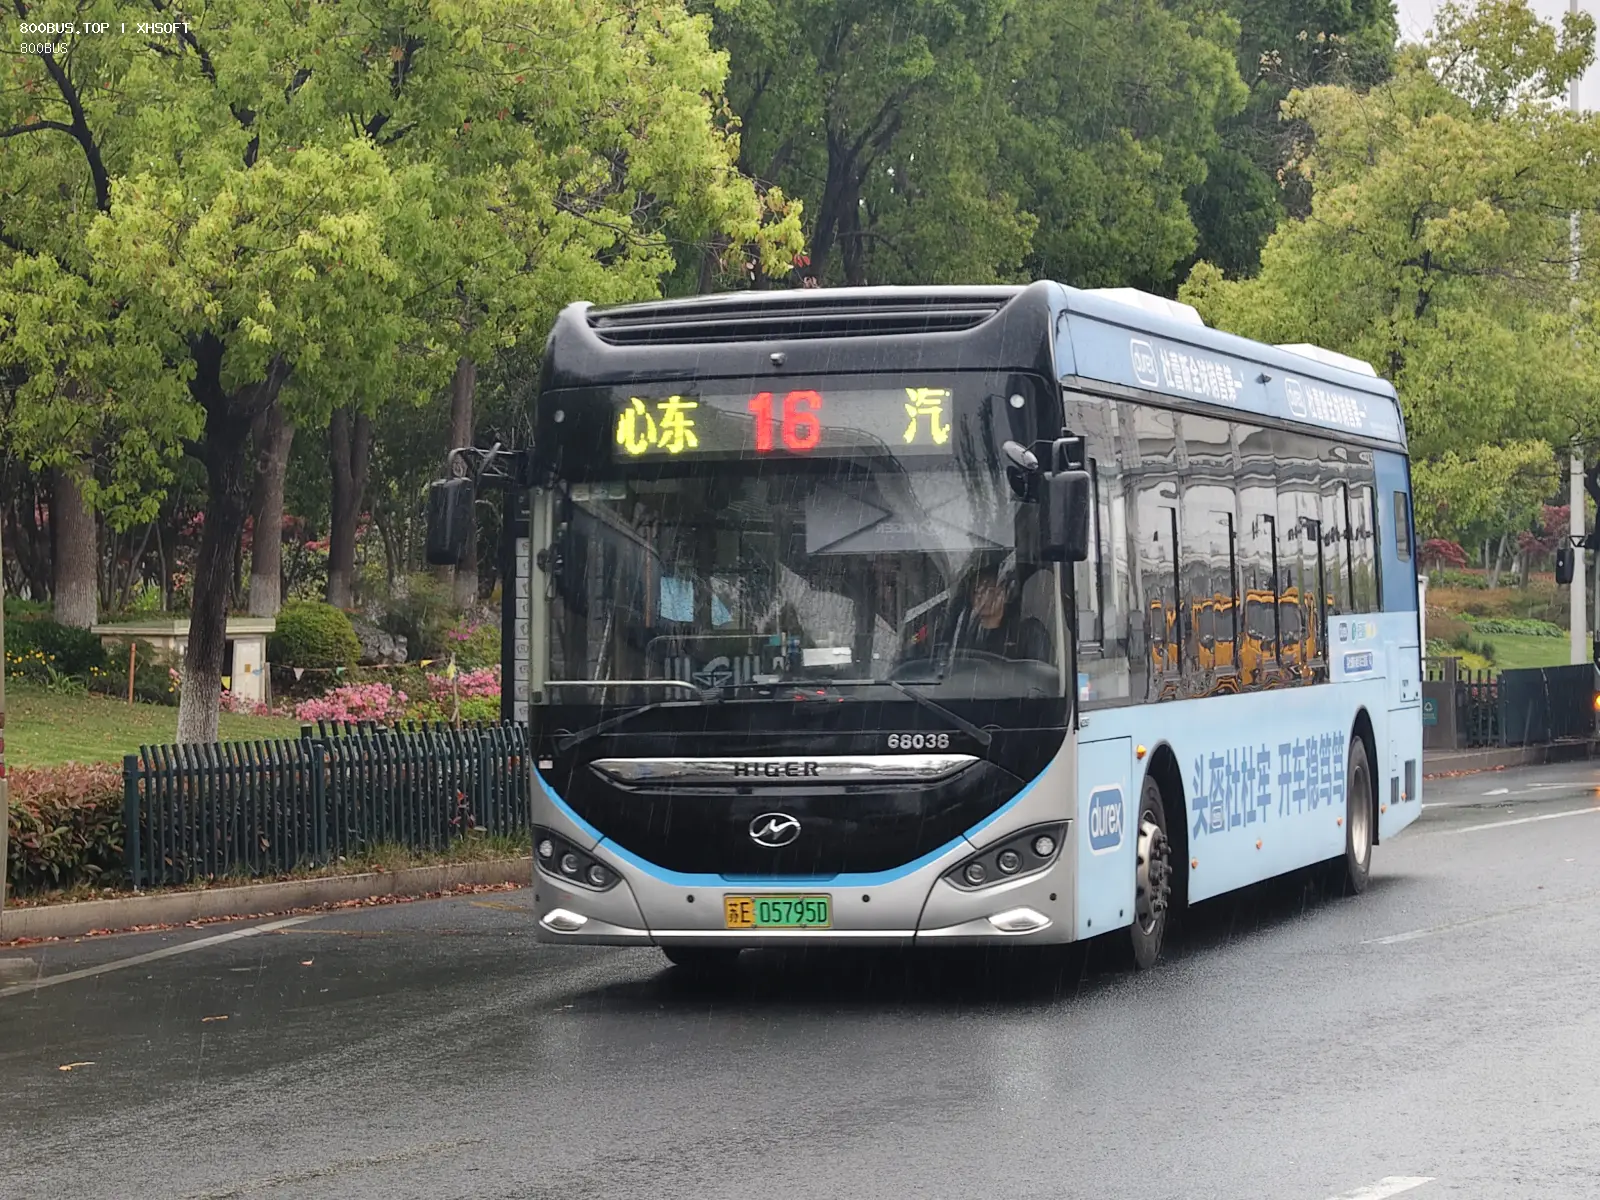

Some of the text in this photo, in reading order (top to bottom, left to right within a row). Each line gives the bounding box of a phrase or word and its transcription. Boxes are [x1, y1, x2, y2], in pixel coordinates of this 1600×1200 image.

[616, 387, 951, 455] 心东 16 汽
[888, 733, 949, 749] 68038
[734, 762, 820, 777] HIGER
[1277, 730, 1345, 818] 开车稳笃笃
[1091, 797, 1122, 838] durex
